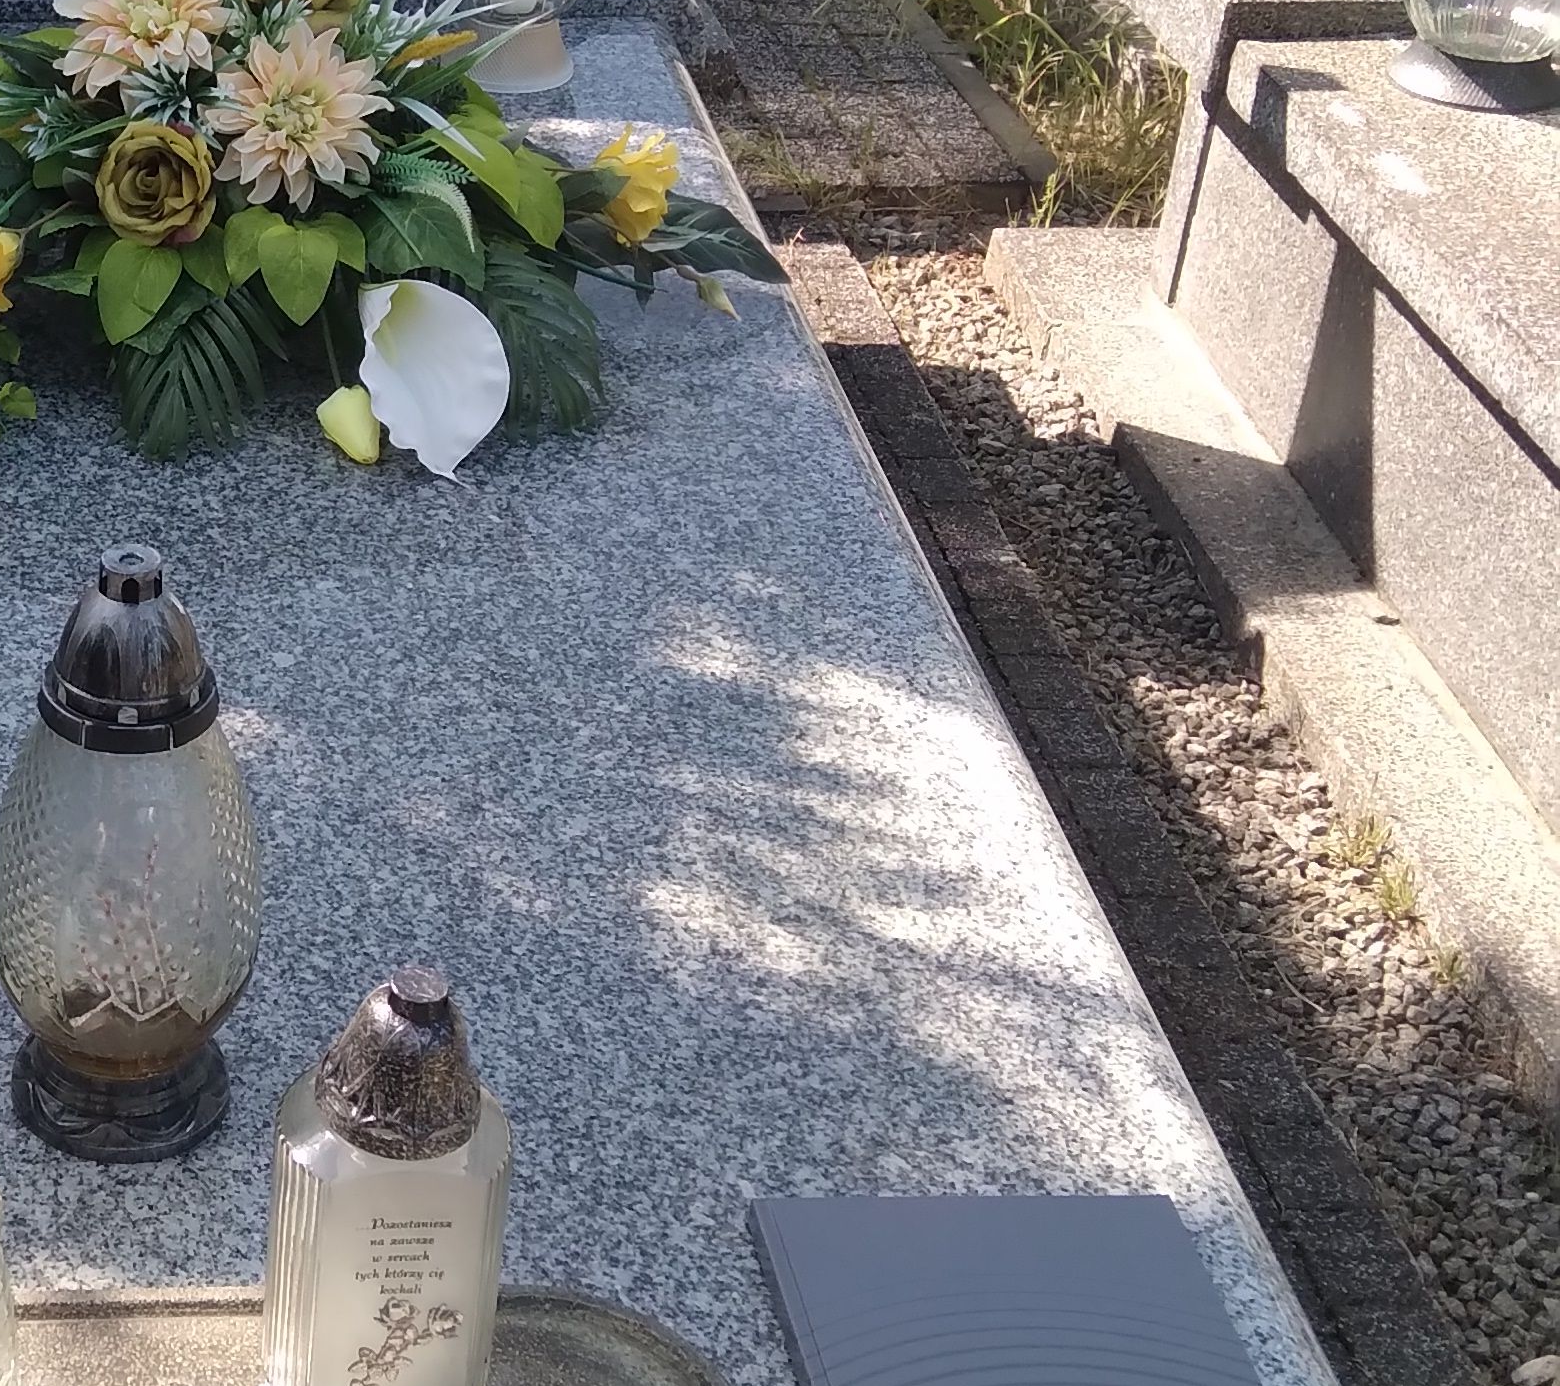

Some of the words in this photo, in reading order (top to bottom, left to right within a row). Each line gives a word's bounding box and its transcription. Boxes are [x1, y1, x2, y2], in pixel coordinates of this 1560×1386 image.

[387, 1251, 430, 1262] sercach
[355, 1269, 380, 1282] tych
[385, 1268, 423, 1281] którzy
[380, 1284, 422, 1294] kochali
